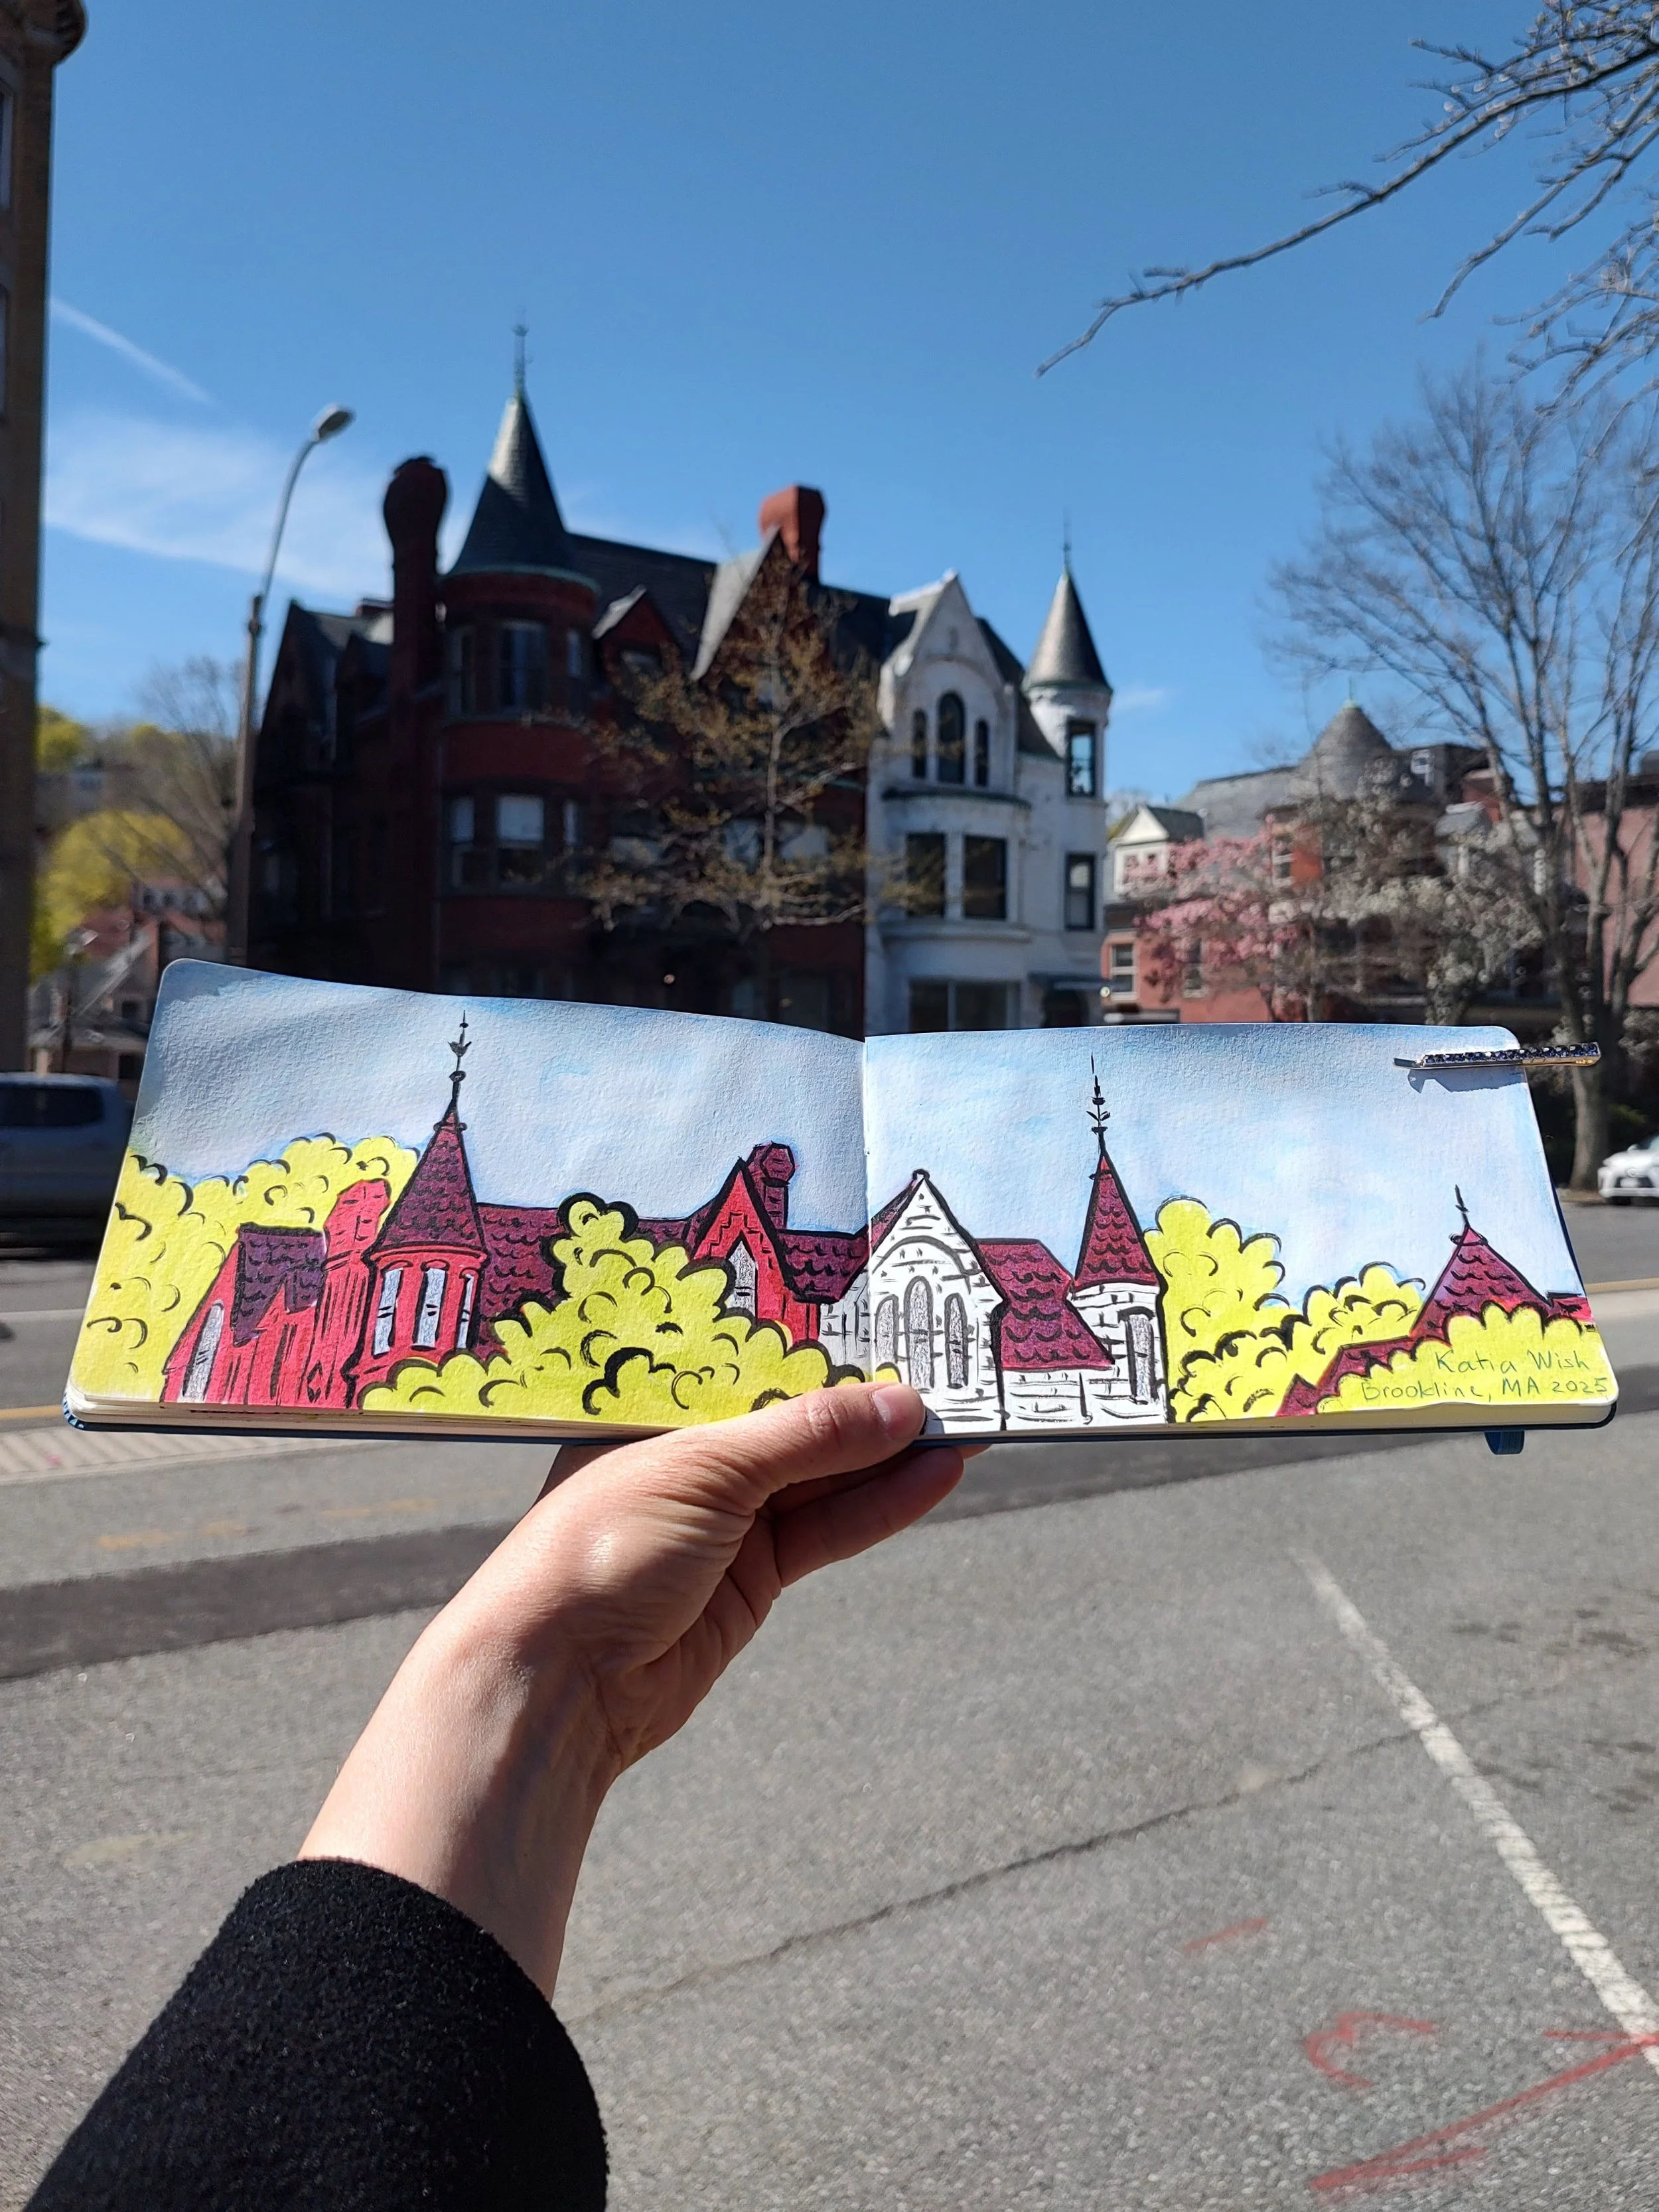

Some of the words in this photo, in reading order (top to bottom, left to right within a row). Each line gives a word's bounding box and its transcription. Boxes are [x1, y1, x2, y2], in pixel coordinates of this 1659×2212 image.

[1435, 1348, 1517, 1374] Katia
[1527, 1349, 1590, 1371] Wish
[1361, 1380, 1492, 1402] Brookline,
[1502, 1377, 1540, 1397] MA
[1552, 1377, 1609, 1393] 2025
